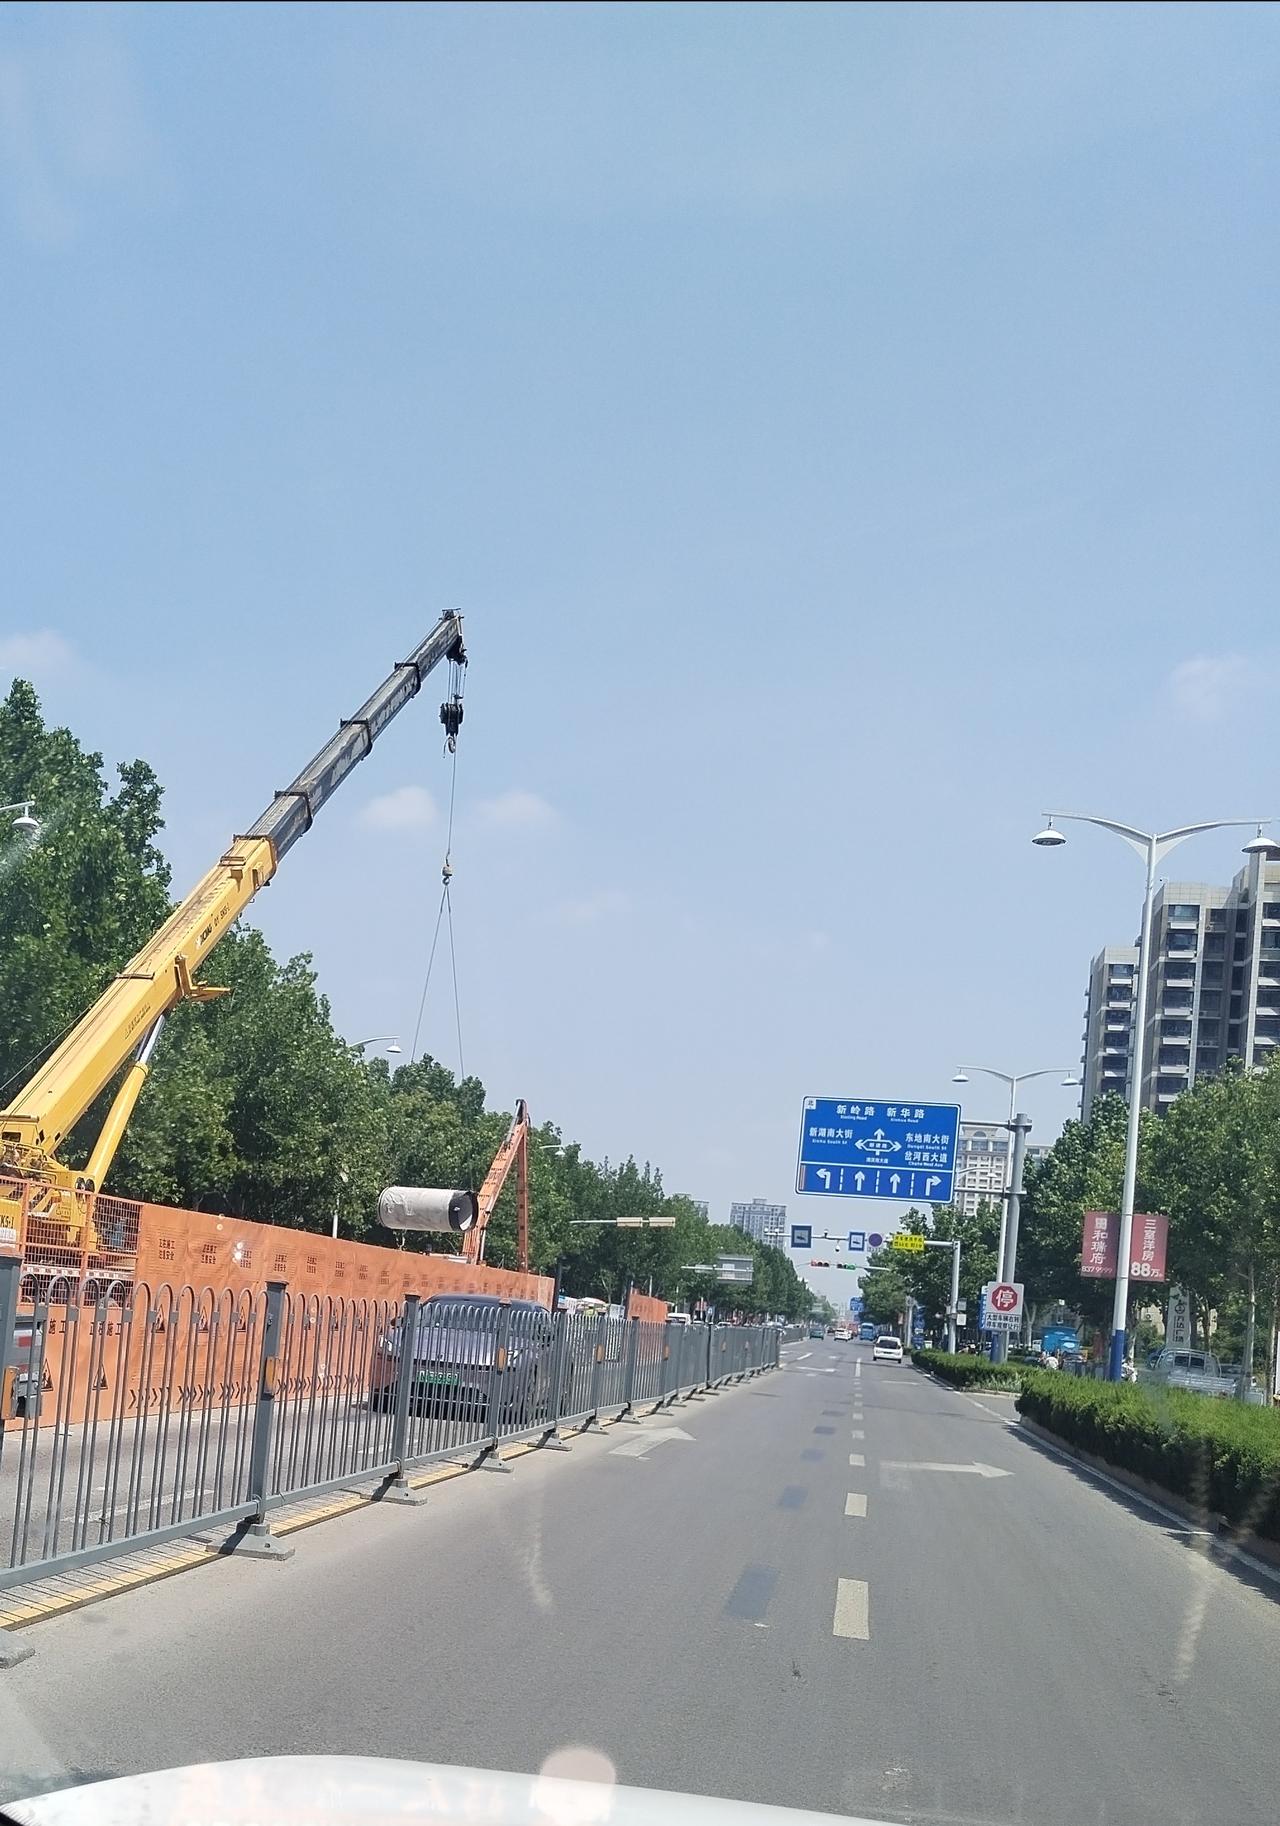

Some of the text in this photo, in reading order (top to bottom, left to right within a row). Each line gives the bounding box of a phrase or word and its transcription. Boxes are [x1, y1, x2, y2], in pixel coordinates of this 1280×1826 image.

[836, 1104, 875, 1116] 新岭路
[886, 1107, 925, 1119] 新华路
[809, 1127, 853, 1139] 新湖南大街
[905, 1132, 950, 1145] 东地南大街
[904, 1151, 948, 1163] 岔河西大道
[995, 1289, 1014, 1308] 停
